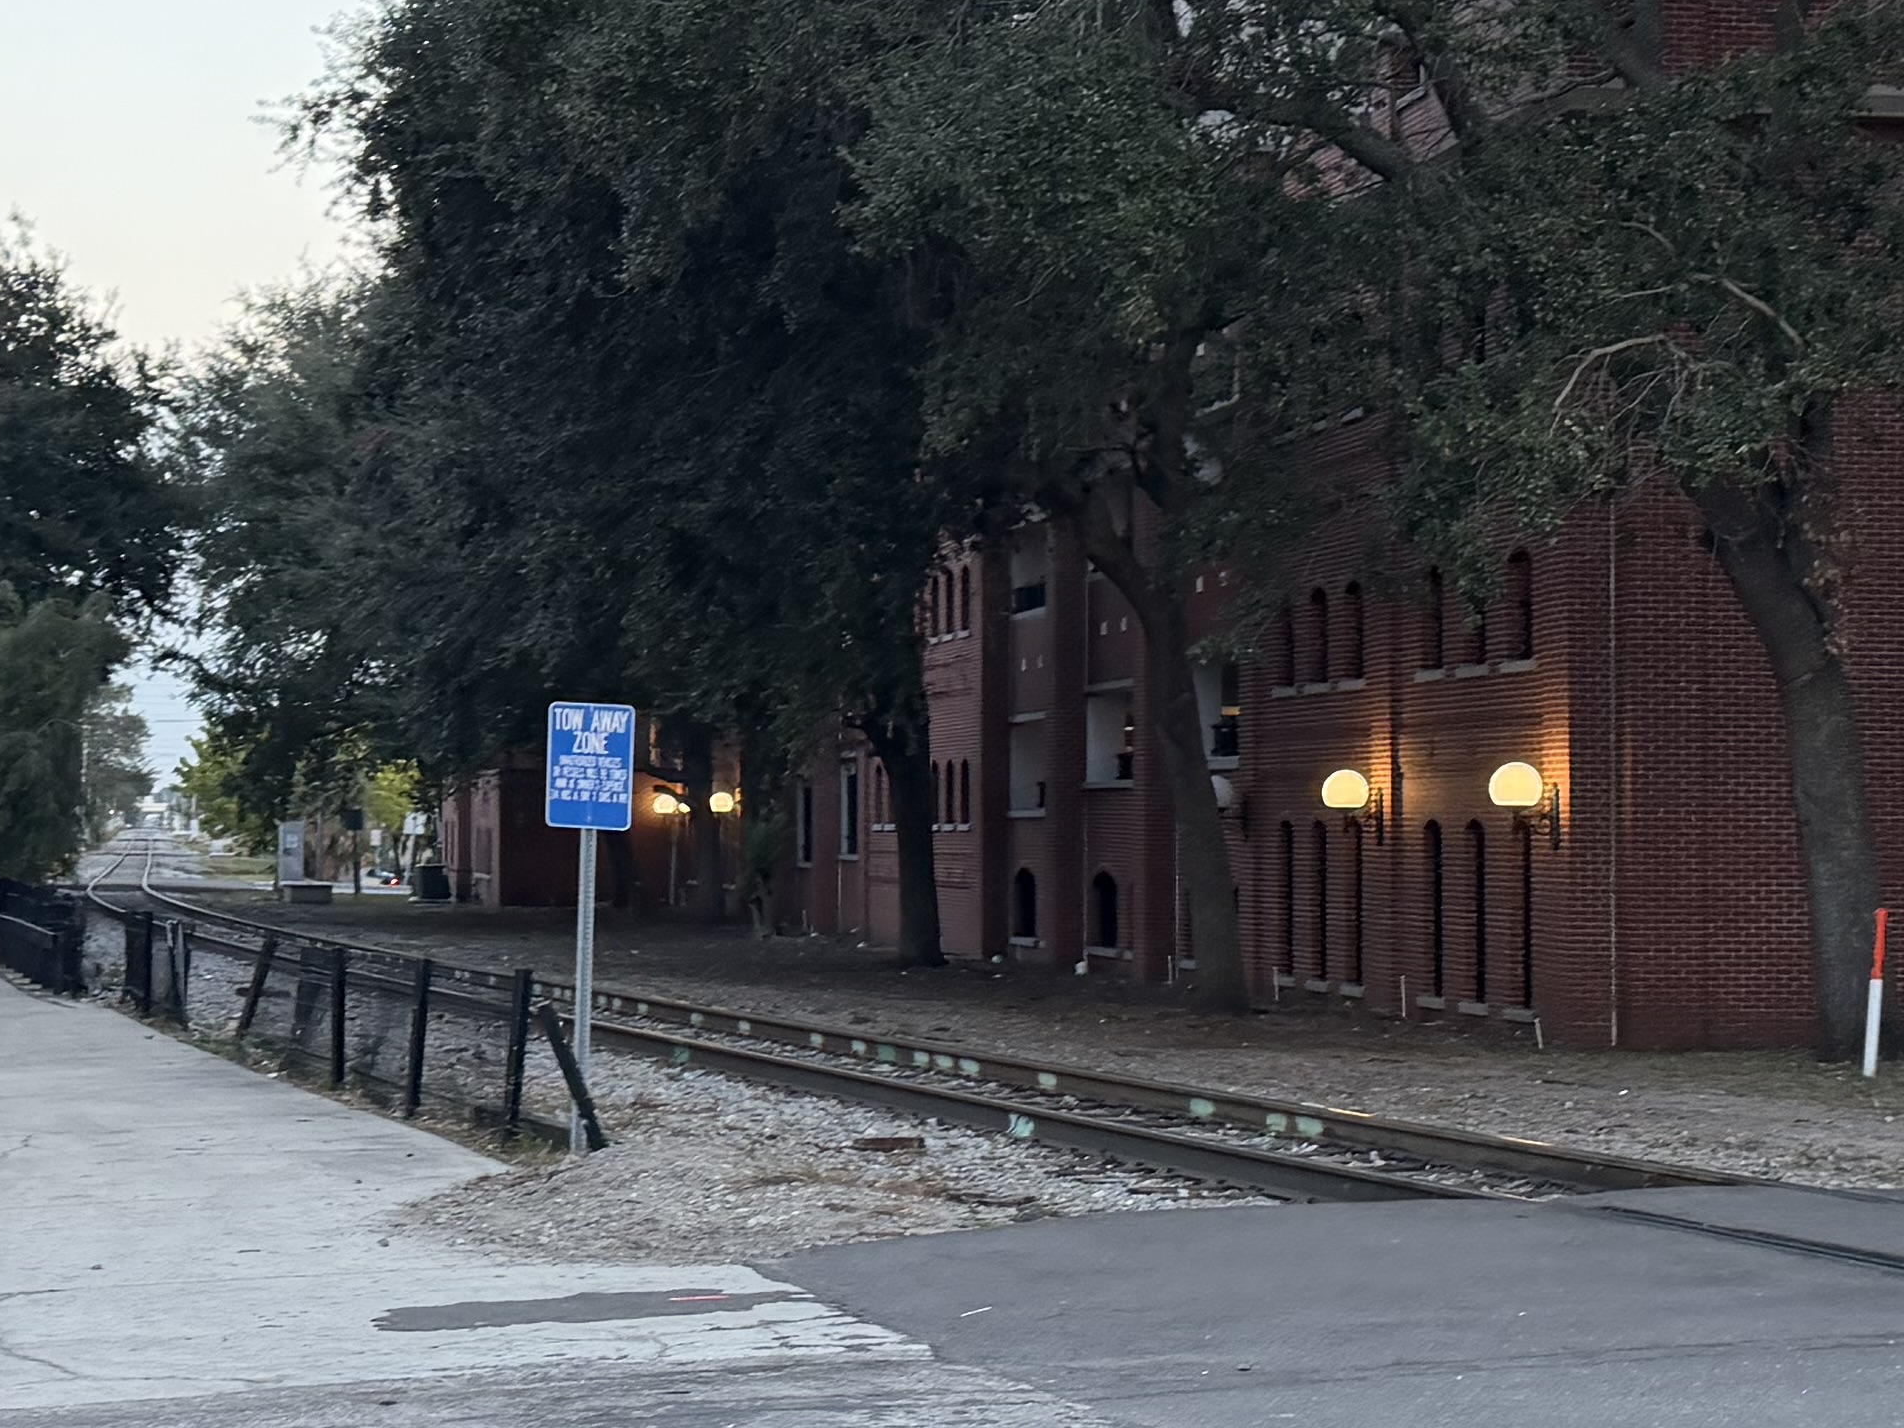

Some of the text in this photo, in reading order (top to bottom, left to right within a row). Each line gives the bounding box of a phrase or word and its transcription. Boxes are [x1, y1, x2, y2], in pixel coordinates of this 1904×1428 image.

[554, 708, 630, 734] TOW AWAY
[572, 731, 609, 754] ZONE
